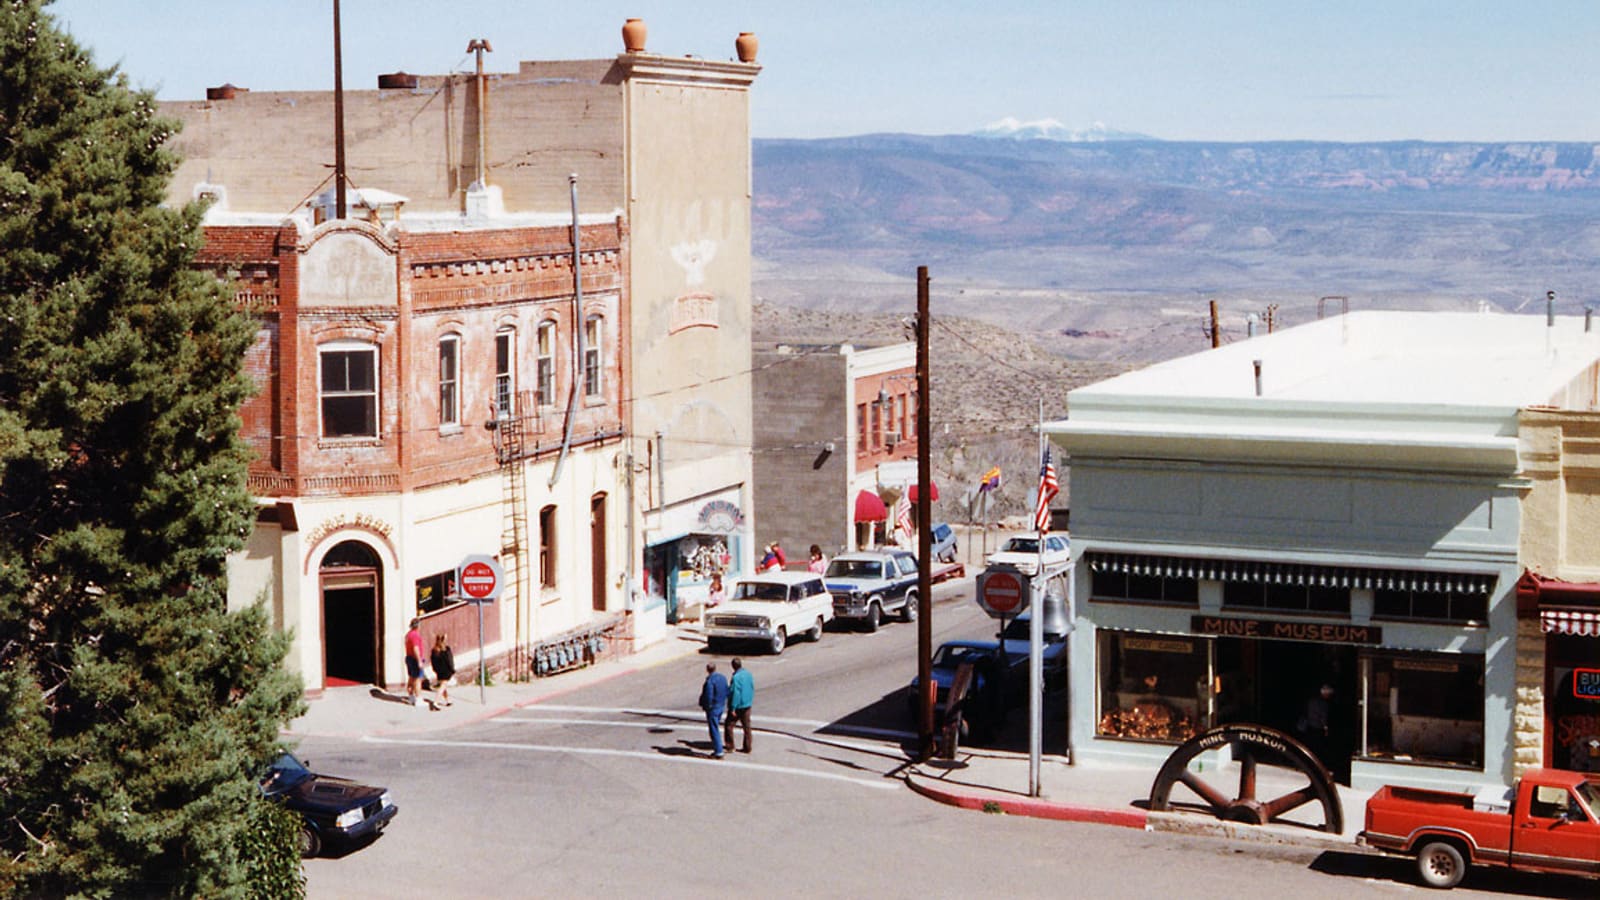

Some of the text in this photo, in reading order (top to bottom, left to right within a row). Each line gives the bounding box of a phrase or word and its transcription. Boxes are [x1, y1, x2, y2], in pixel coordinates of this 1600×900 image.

[1204, 617, 1369, 642] MINE MUSEUM
[1199, 732, 1226, 748] MINE
[1240, 731, 1288, 752] MUSEUM
